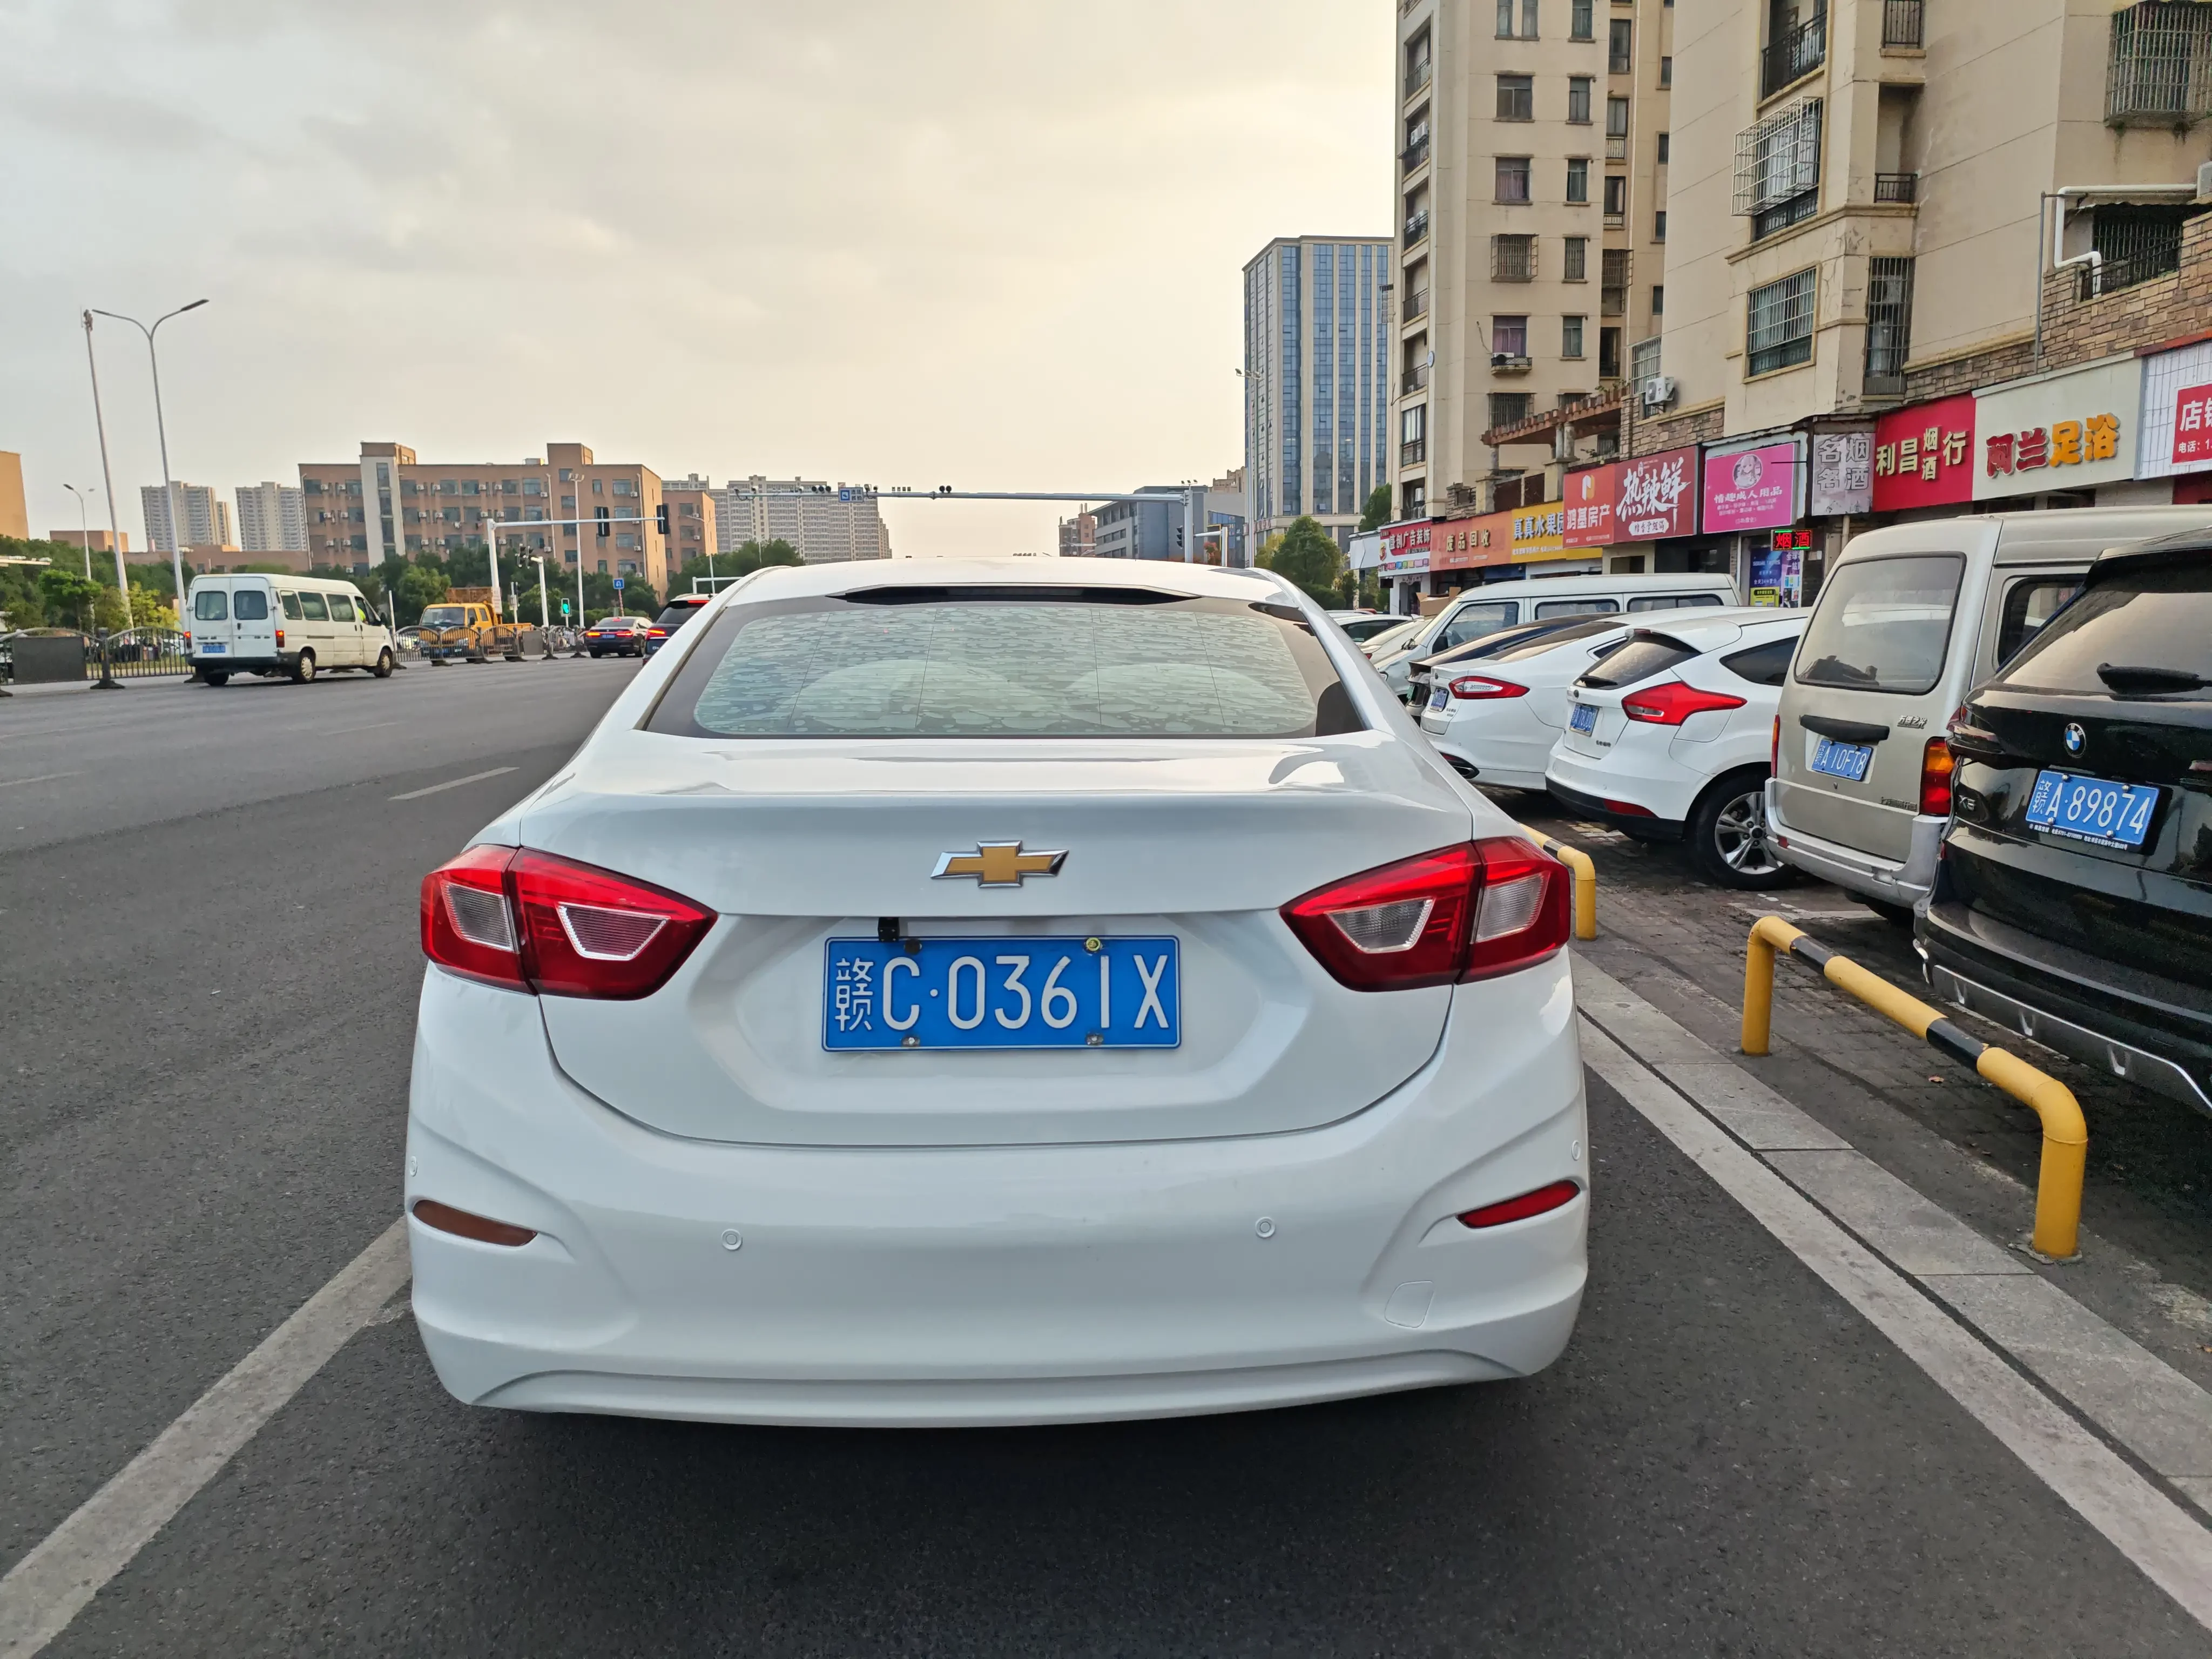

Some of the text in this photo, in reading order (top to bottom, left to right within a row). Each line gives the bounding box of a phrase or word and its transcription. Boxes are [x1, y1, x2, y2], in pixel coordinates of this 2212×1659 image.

[1447, 529, 1490, 551] 废品回收
[1776, 532, 1810, 548] 烟酒
